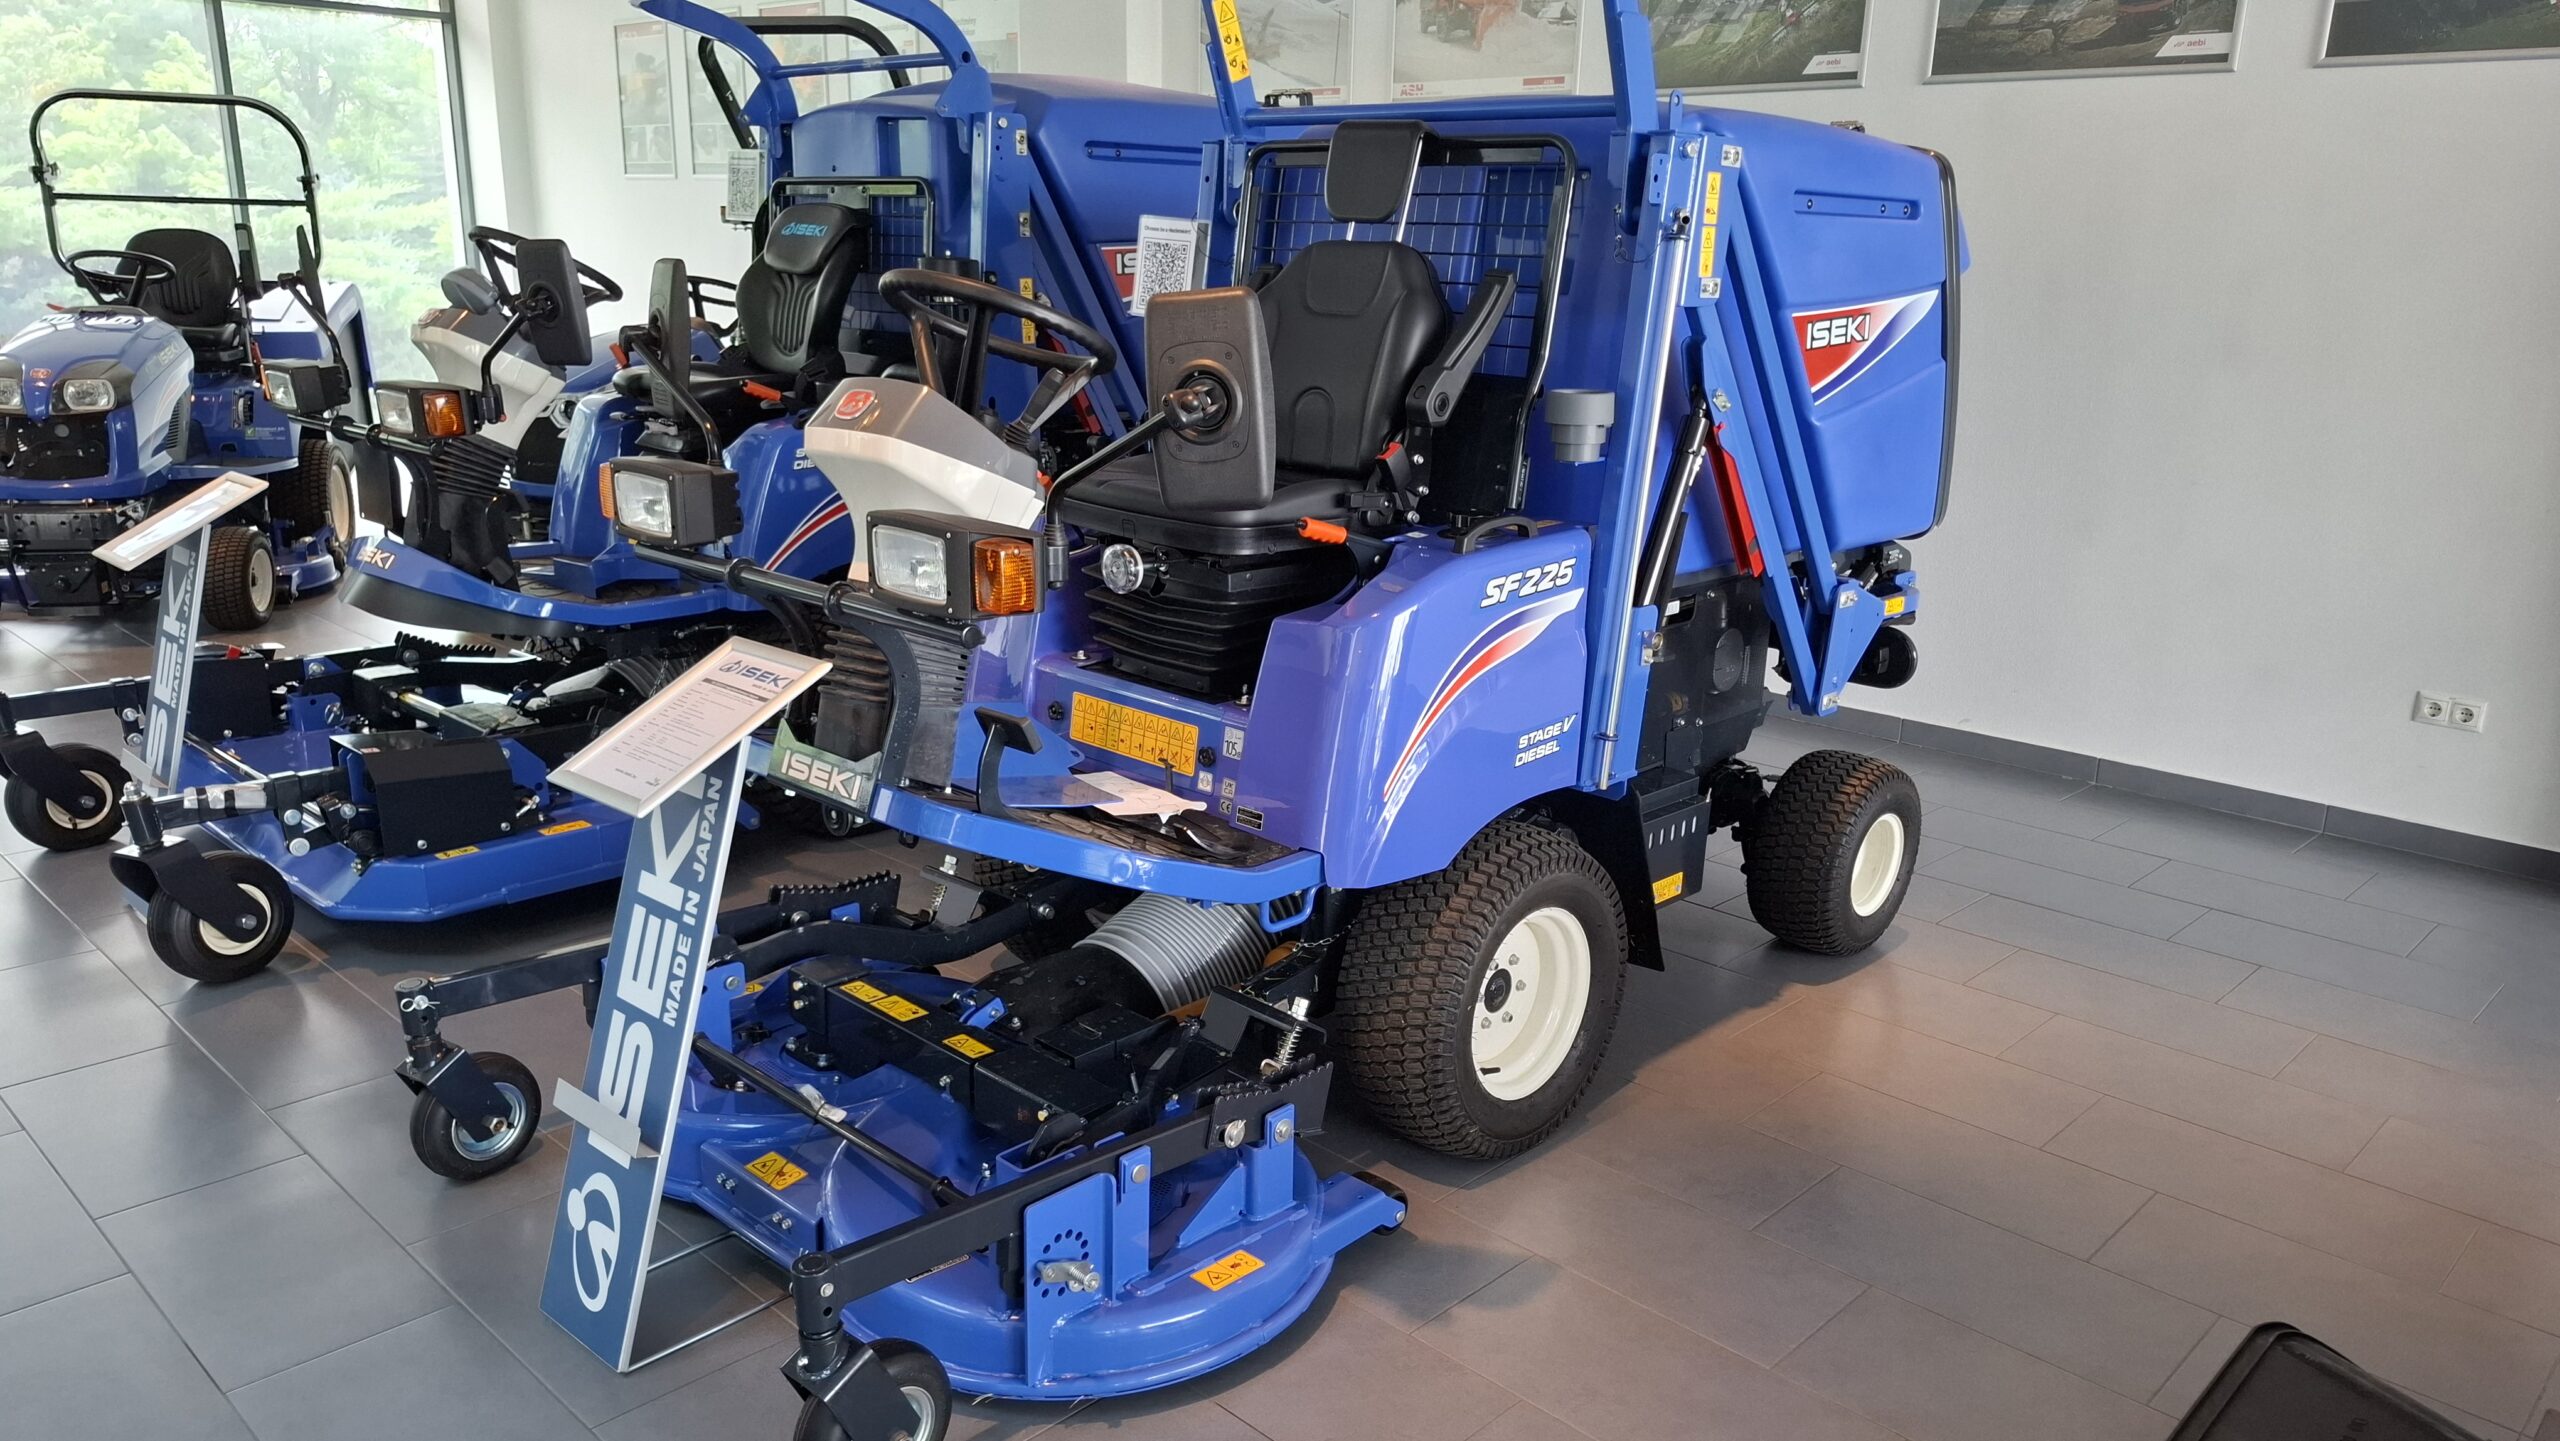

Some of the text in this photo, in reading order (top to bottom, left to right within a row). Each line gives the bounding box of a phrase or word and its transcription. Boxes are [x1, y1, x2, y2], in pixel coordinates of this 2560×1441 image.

[793, 223, 828, 237] ISEKI
[1806, 314, 1871, 350] ISEKI
[171, 551, 197, 709] MADE IN JAPAN
[736, 664, 795, 690] ISEKI
[1517, 713, 1578, 750] STAGE V
[1513, 739, 1561, 768] DIESEL
[781, 749, 862, 801] ISEKI
[662, 776, 723, 1027] MADE IN JAPAN
